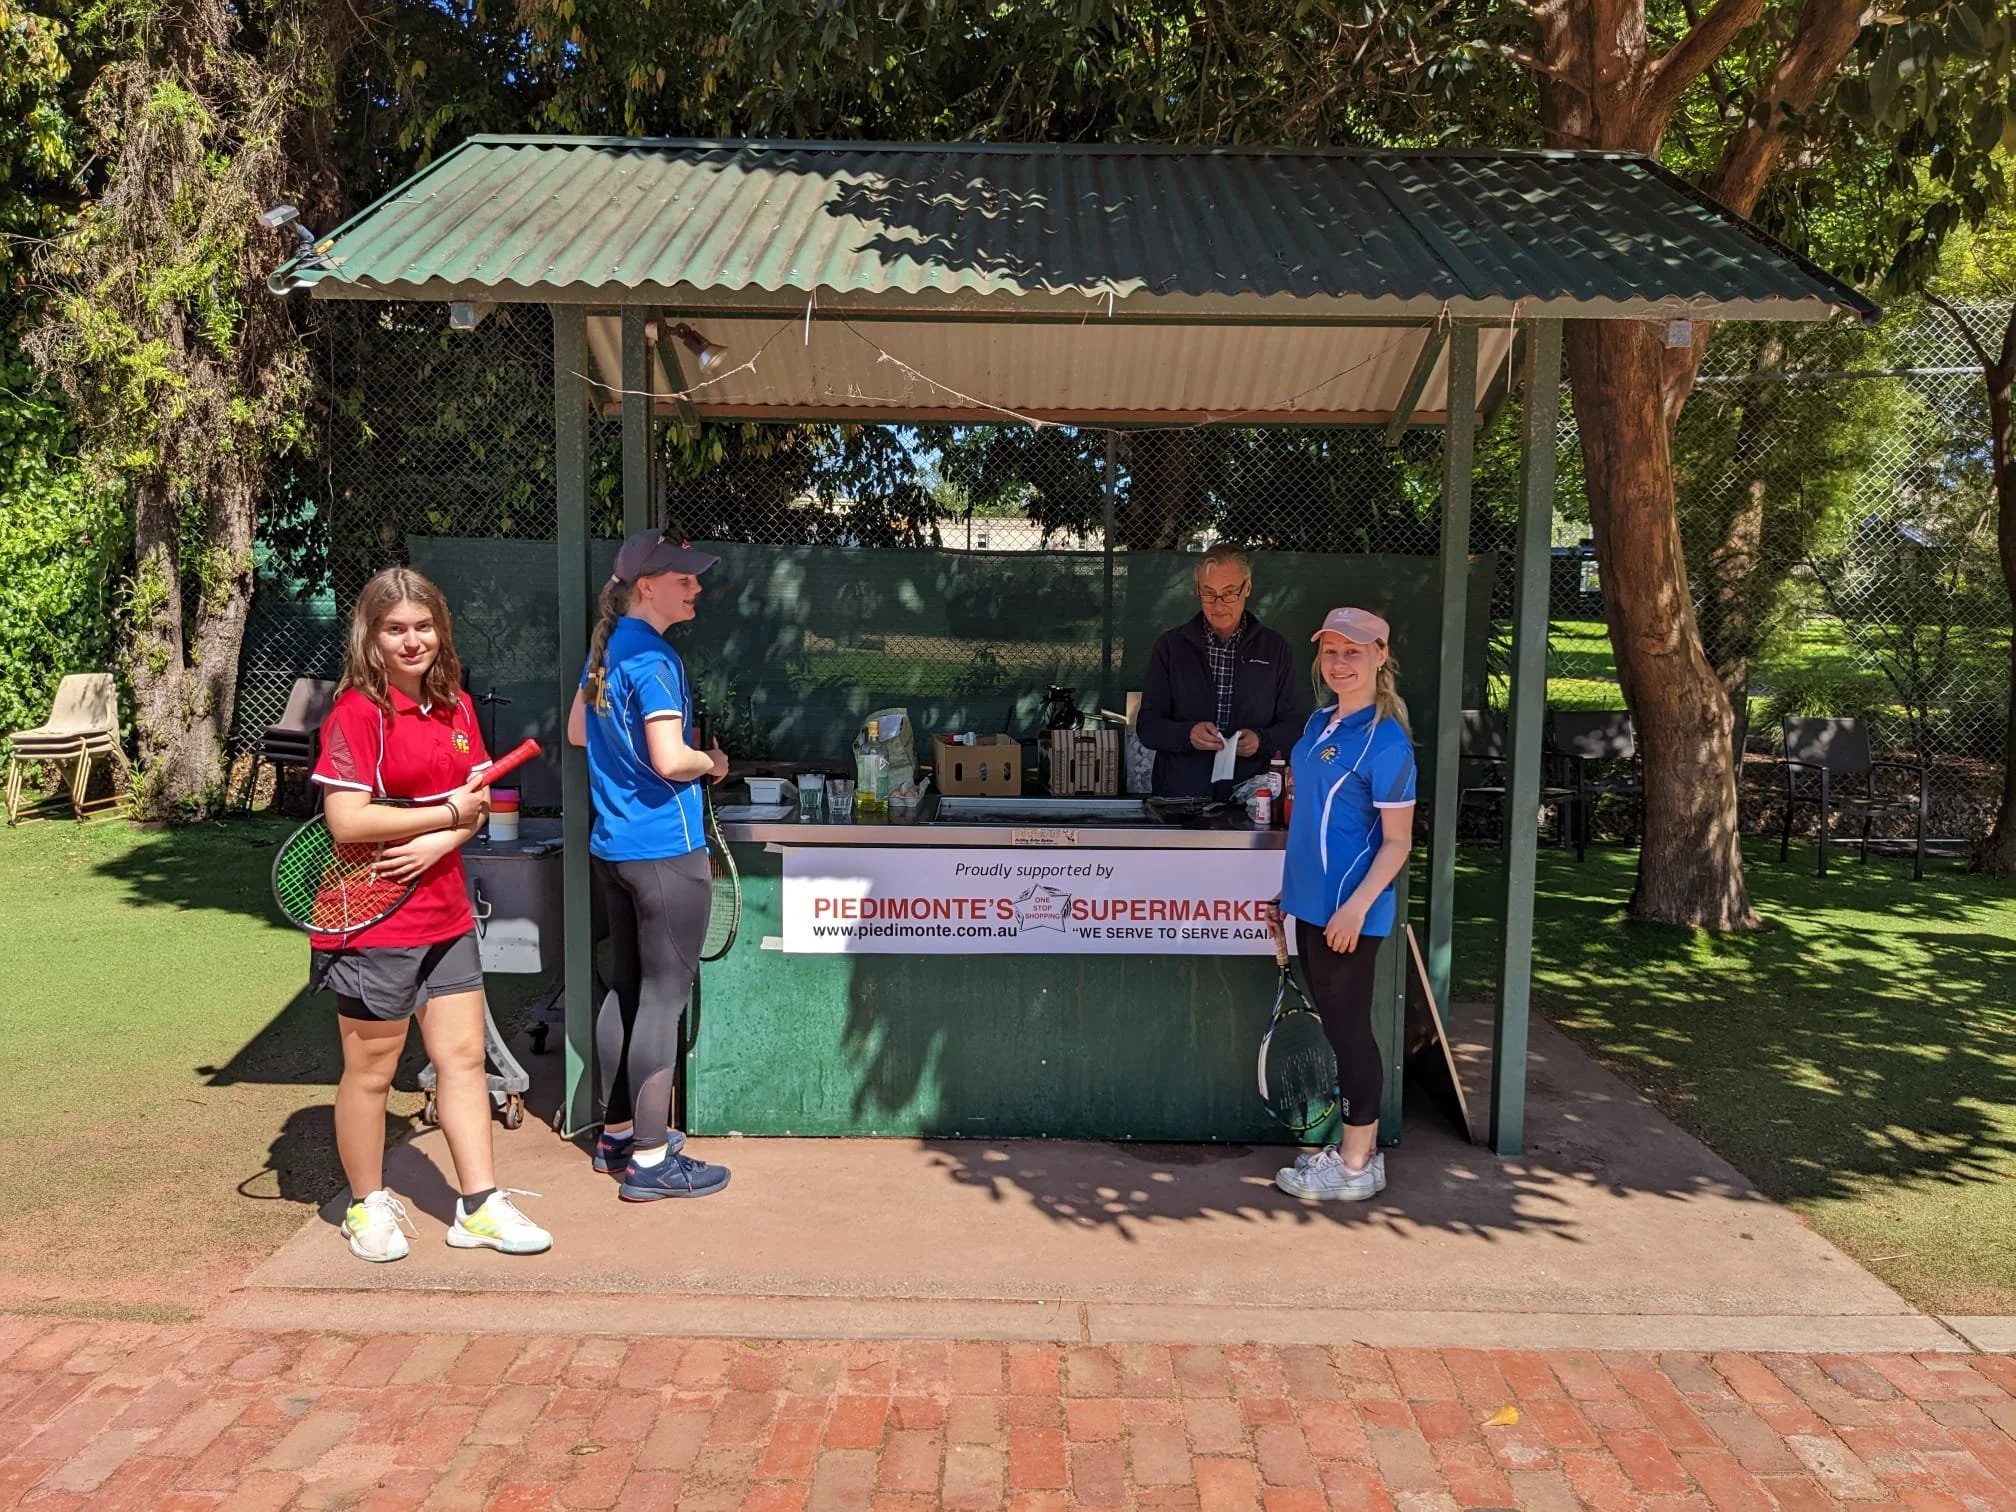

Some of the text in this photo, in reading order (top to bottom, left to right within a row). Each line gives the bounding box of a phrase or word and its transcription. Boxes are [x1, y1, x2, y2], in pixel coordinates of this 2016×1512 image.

[955, 862, 1114, 879] Proudly supported by
[1034, 896, 1050, 904] ONE
[814, 897, 1267, 921] PIEDIMONTE’S SUPERMARKE
[1024, 912, 1060, 920] SHOPPING
[813, 922, 1017, 940] www.piedimonte.com.au
[1106, 927, 1154, 939] SERVE
[1158, 927, 1177, 939] TO
[1181, 927, 1229, 940] SERVE
[1232, 928, 1272, 940] AGAI
